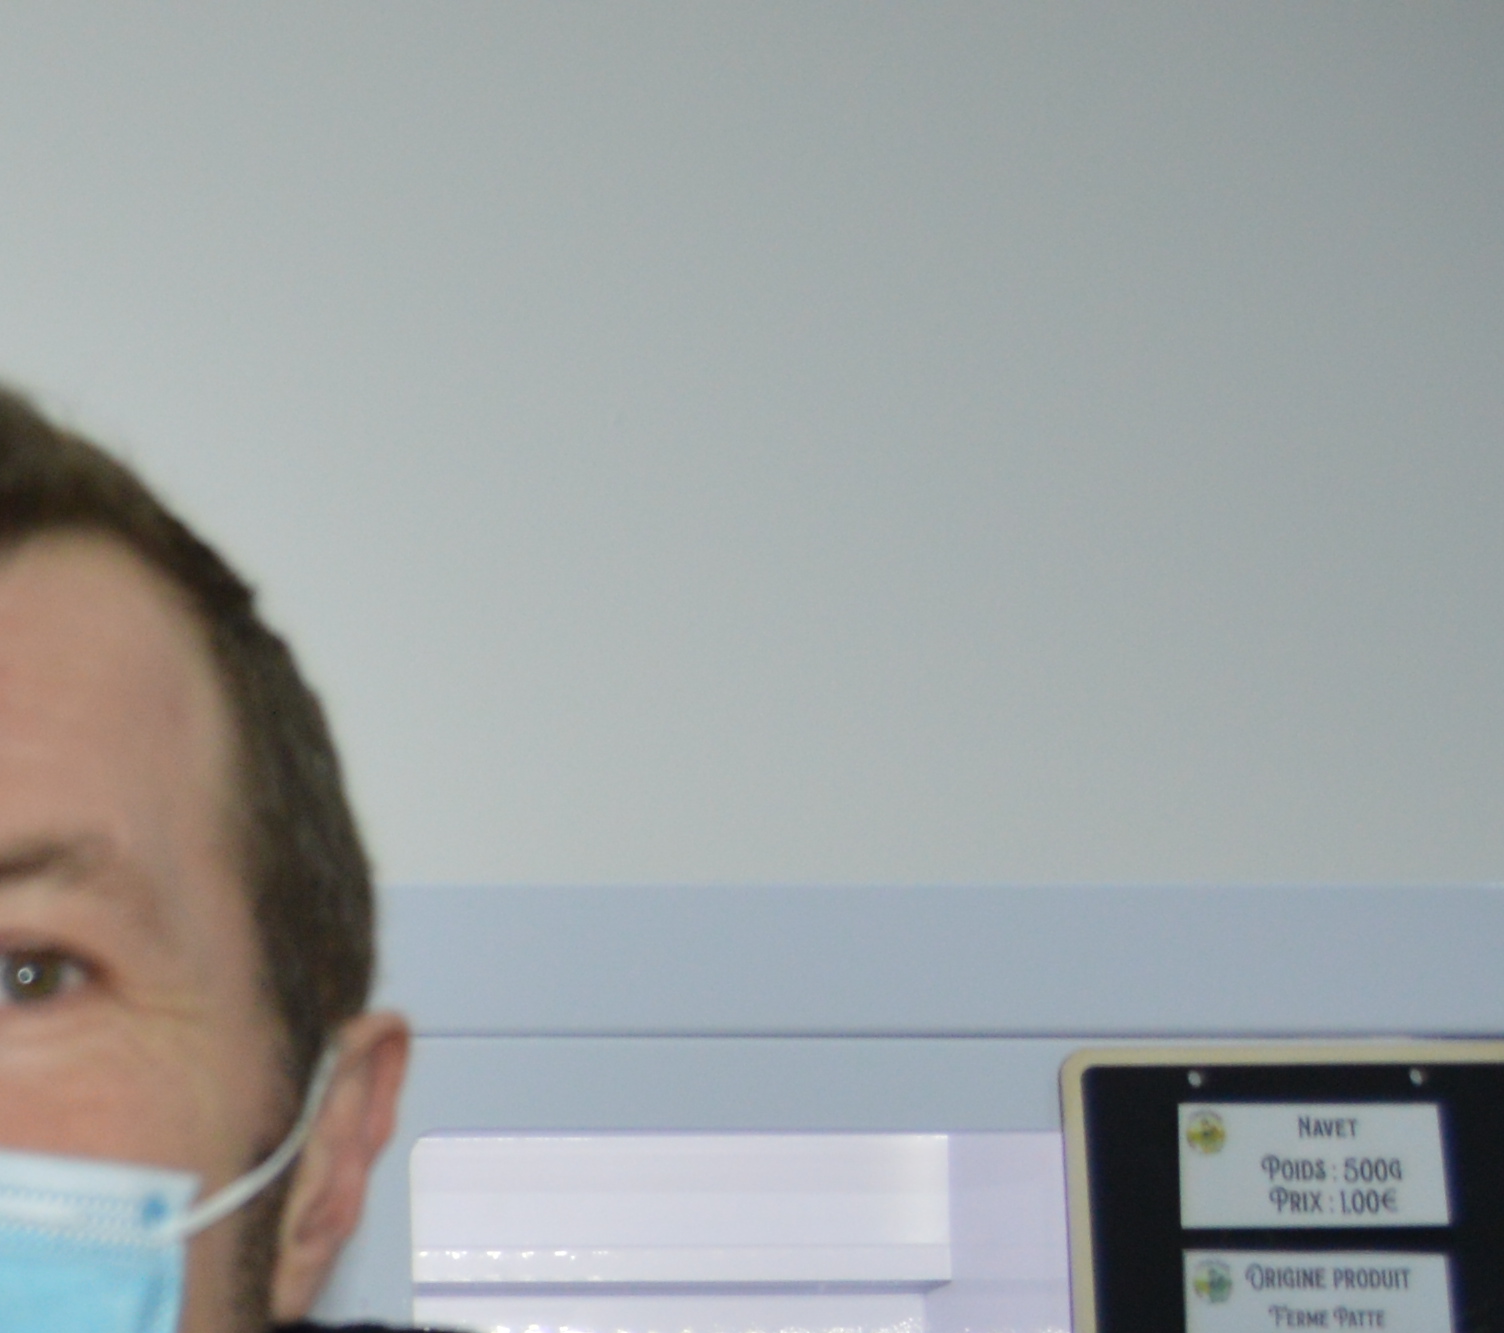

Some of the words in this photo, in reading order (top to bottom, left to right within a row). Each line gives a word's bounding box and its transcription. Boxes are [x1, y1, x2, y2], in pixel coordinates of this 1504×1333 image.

[1298, 1117, 1357, 1138] NAVET
[1261, 1155, 1327, 1181] POIDS
[1344, 1158, 1402, 1181] 500G
[1269, 1187, 1323, 1214] PRIX
[1245, 1264, 1326, 1291] ORIGINE
[1333, 1268, 1410, 1290] PRODUIT
[1269, 1306, 1329, 1328] FERME
[1334, 1306, 1385, 1328] PATTE
